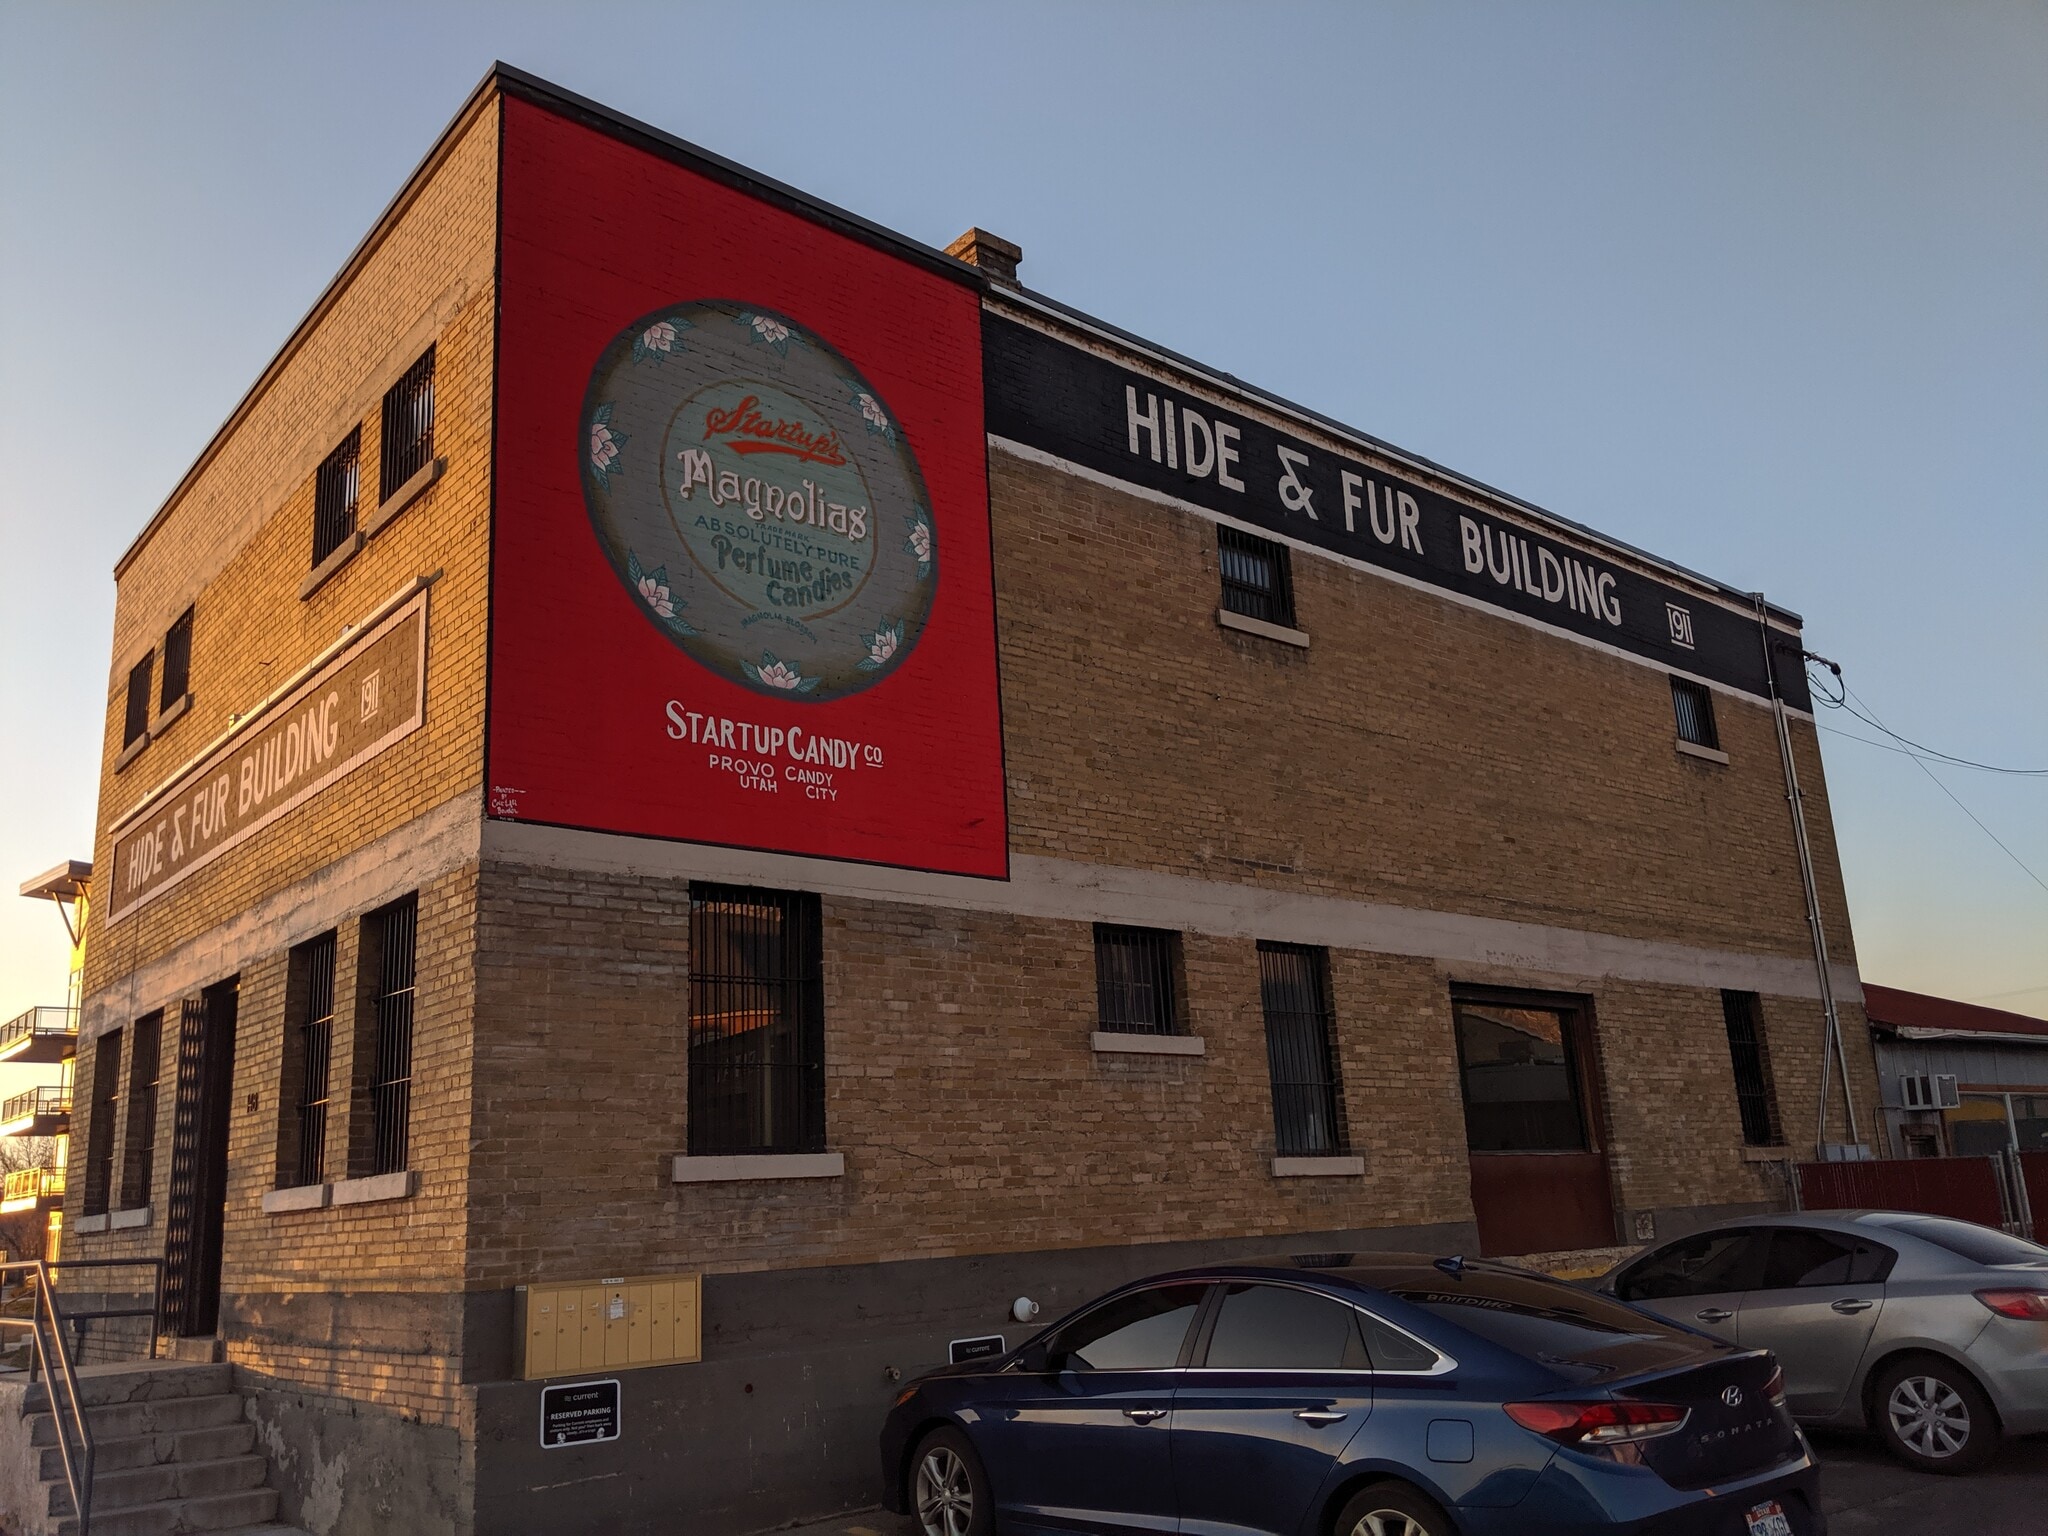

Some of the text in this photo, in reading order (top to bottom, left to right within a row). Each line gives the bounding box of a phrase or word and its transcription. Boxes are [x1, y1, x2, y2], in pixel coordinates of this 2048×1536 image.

[703, 394, 847, 466] Startup's
[677, 448, 868, 542] Magnolias
[1125, 385, 1622, 627] HIDE & FUR BUILDING
[694, 514, 860, 570] ABSOLUTELY PURE
[755, 522, 810, 542] TRADE MARK
[710, 534, 813, 584] Perfume
[766, 566, 853, 607] Candies
[1666, 605, 1695, 647] 1911
[360, 672, 380, 720] 1911
[665, 699, 784, 757] STARTUP
[787, 726, 860, 770] CANDY
[709, 754, 774, 778] PROVO
[739, 775, 778, 794] UTAH
[785, 765, 833, 787] CANDY
[127, 690, 339, 893] HIDE & FUR BUILDING
[805, 785, 838, 802] CITY
[550, 1406, 611, 1420] RESERVED PARKING
[572, 1391, 599, 1401] current
[1700, 1417, 1773, 1443] SONATA
